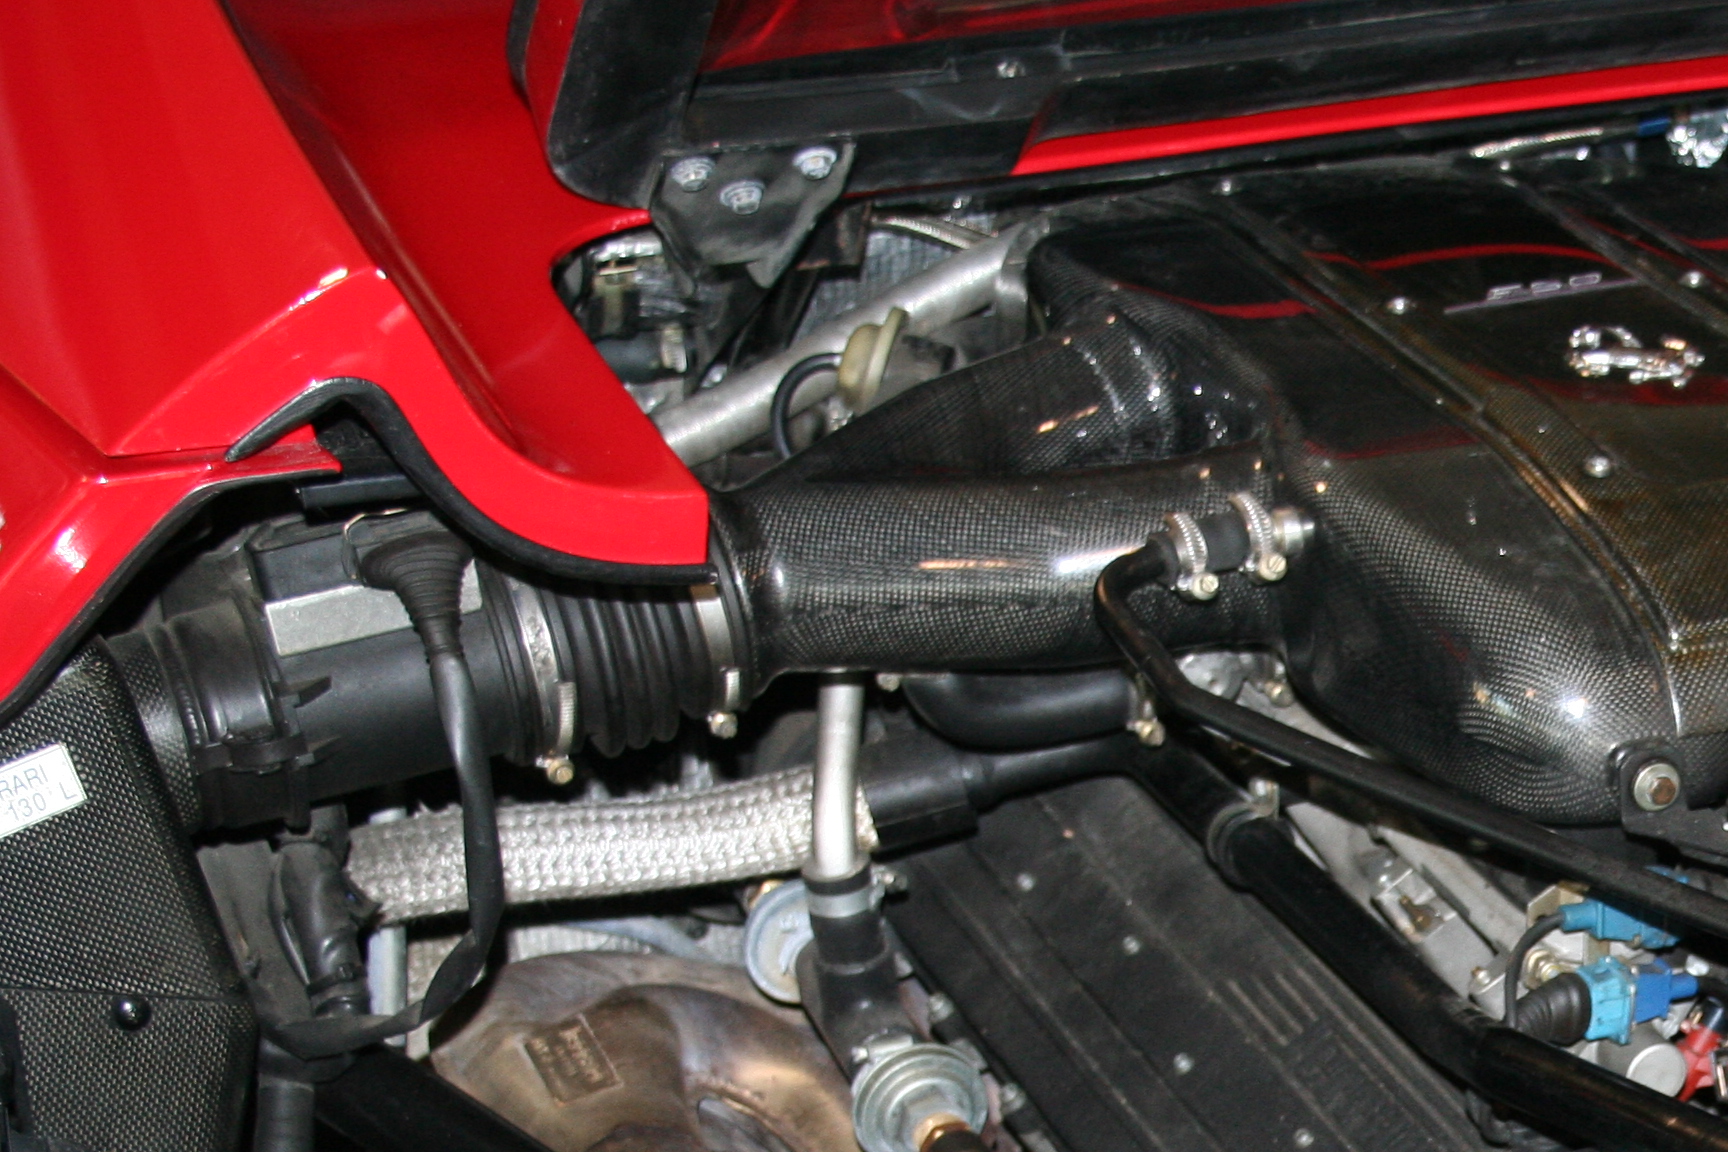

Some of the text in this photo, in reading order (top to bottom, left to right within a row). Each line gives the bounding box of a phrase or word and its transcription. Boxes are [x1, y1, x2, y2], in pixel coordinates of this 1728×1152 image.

[0, 764, 48, 800] RARI
[8, 781, 78, 821] 130 L
